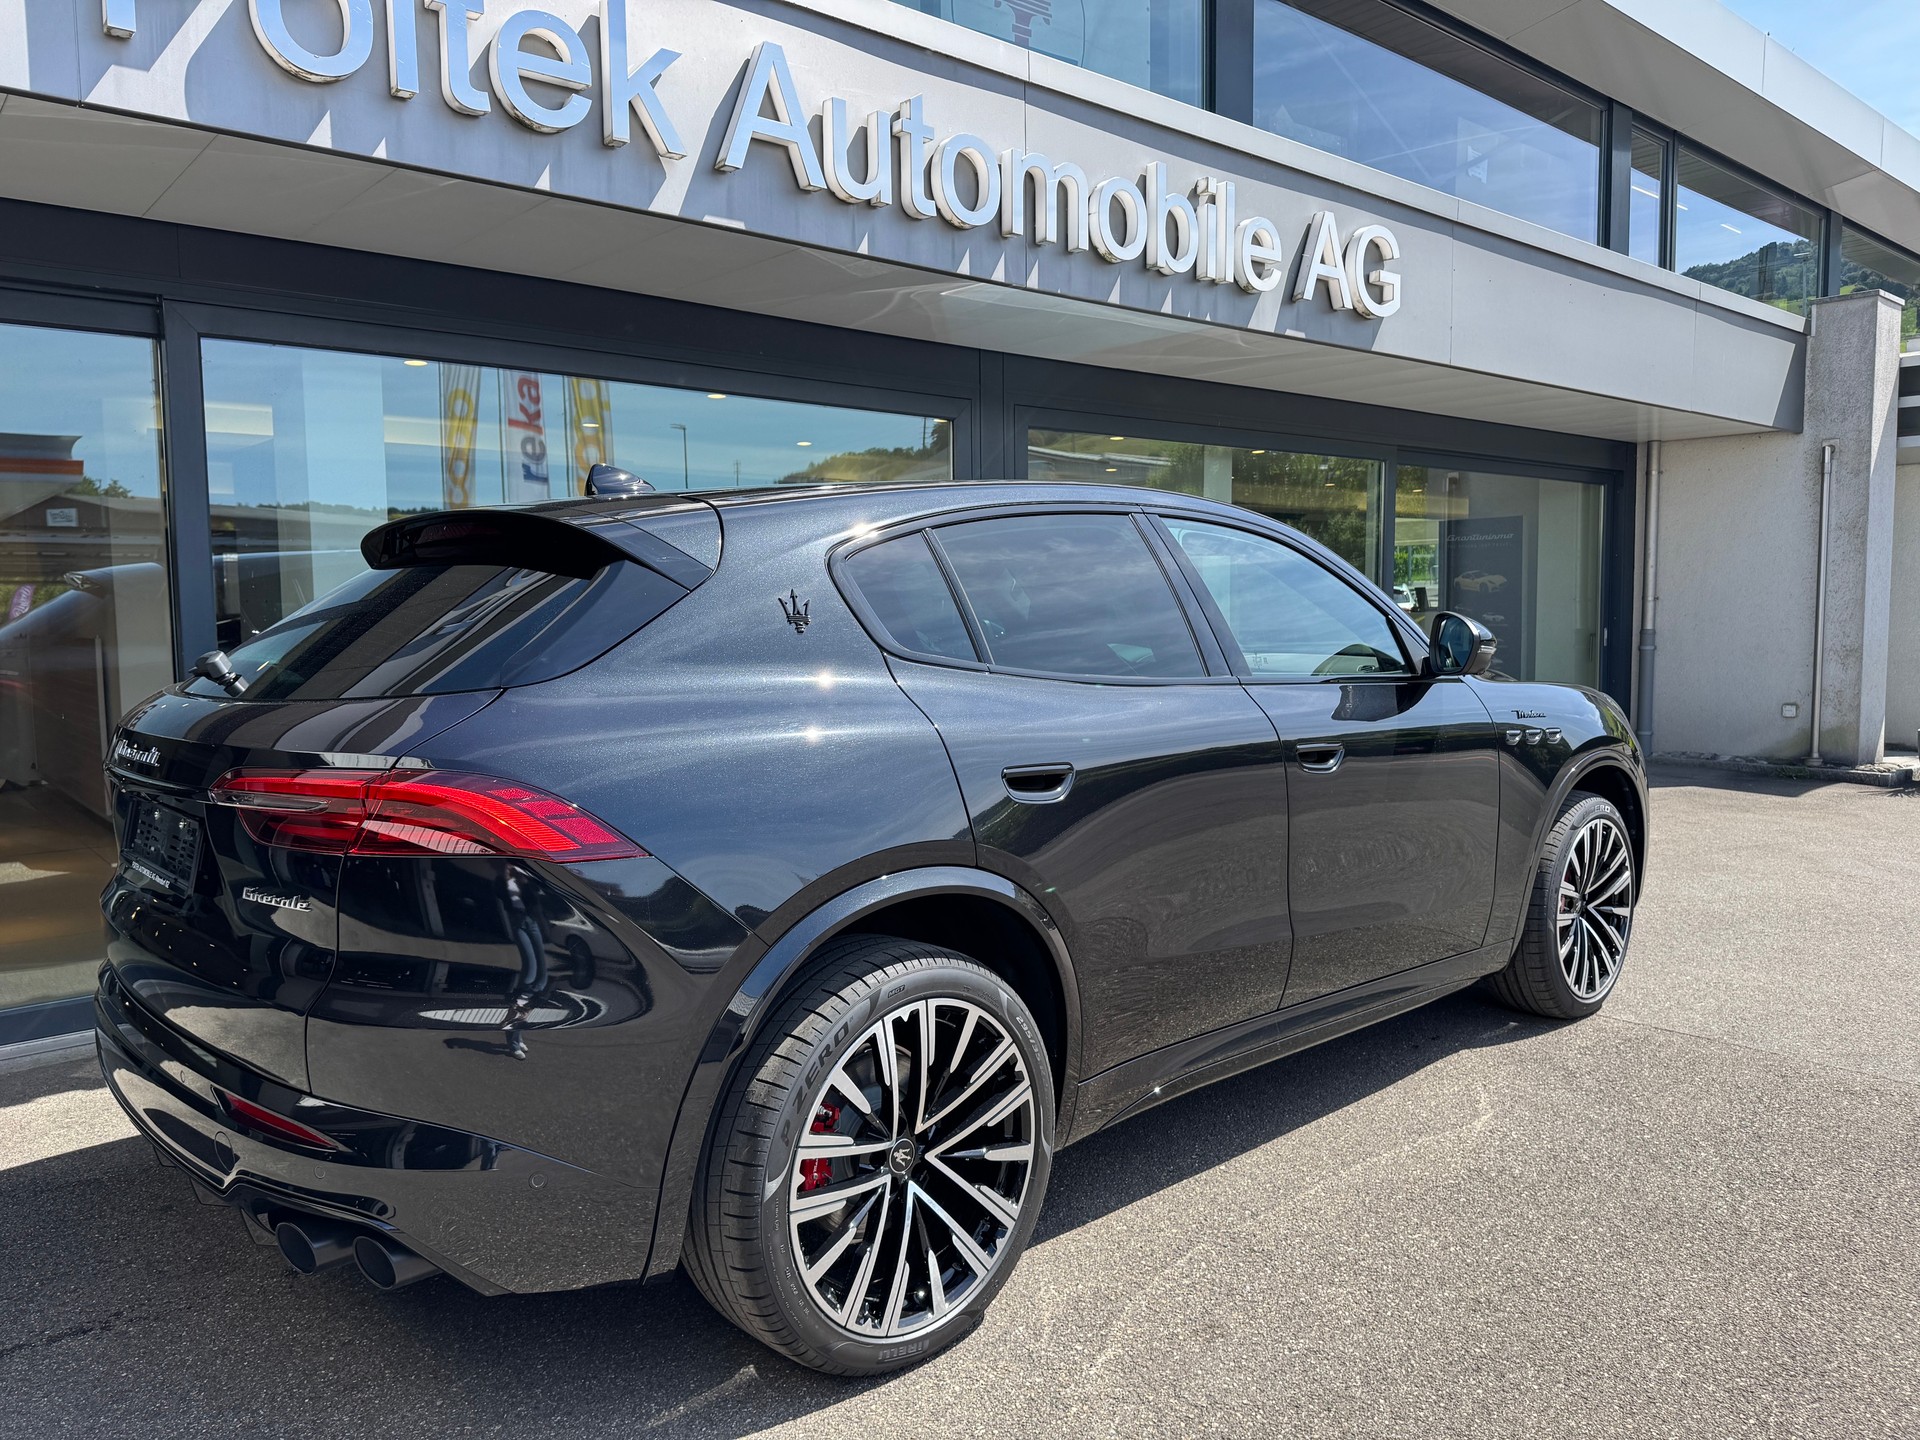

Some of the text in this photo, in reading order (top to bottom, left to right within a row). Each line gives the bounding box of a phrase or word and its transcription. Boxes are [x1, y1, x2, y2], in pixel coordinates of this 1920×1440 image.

[103, 0, 1402, 320] oltek Automobile AG
[508, 375, 548, 484] reka
[793, 1021, 849, 1115] ZERO
